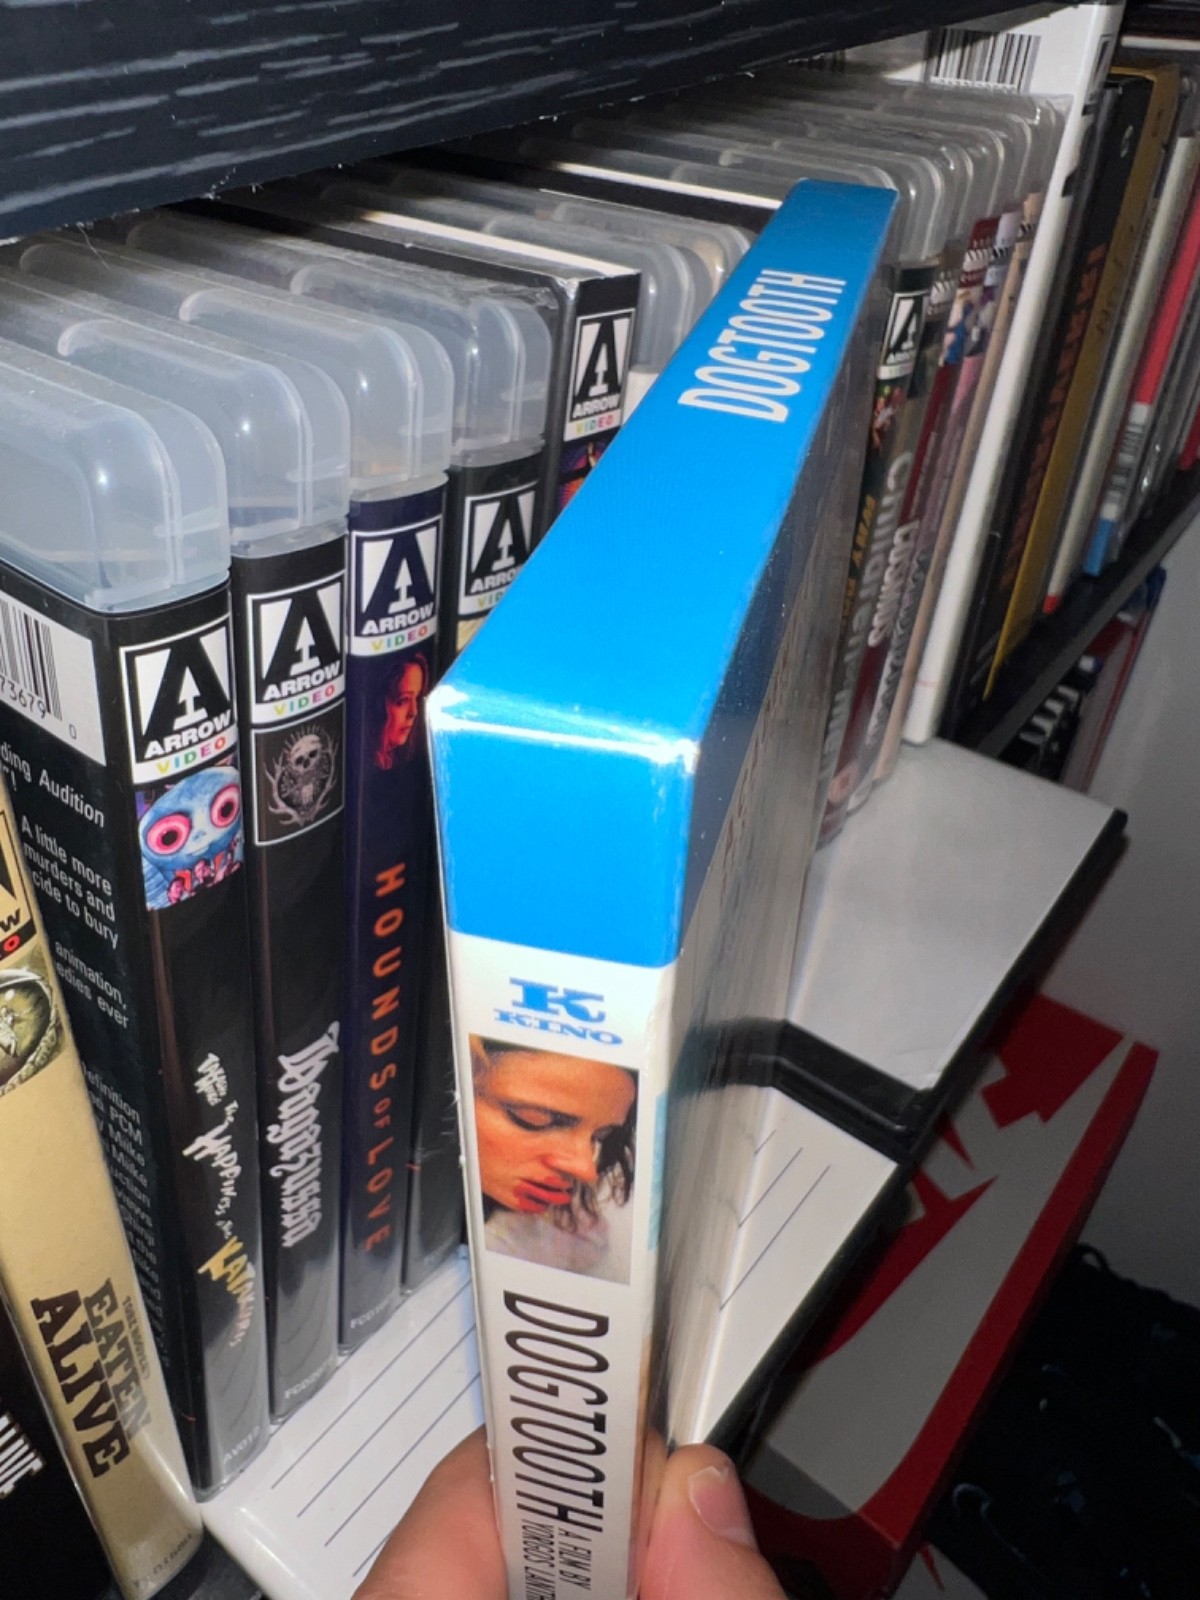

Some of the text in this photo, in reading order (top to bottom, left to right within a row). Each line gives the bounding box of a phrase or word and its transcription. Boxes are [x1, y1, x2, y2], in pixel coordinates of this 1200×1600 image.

[677, 269, 846, 423] DOGTOOTH
[572, 394, 622, 419] ARROW
[576, 417, 614, 436] VIDEO
[470, 566, 518, 593] ARRO
[361, 602, 434, 636] ARROW
[371, 625, 428, 651] VIDEO
[263, 660, 341, 701] ARROW
[274, 684, 336, 716] VIDEO
[144, 709, 232, 760] ARROW
[156, 736, 227, 774] VIDEO
[39, 768, 105, 828] Audition
[35, 824, 67, 864] little
[71, 856, 112, 897] more
[65, 893, 80, 917] to
[84, 906, 118, 949] bury
[86, 890, 116, 922] and
[97, 996, 129, 1029] ever
[509, 976, 606, 1024] K
[494, 1008, 623, 1045] KINO
[366, 863, 405, 1252] HOUNDS OF LOVE
[84, 1277, 152, 1441] EATEN
[30, 1289, 131, 1478] ALIVE
[503, 1290, 609, 1533] DOGTOOTH
[521, 1518, 555, 1568] YORGOS
[558, 1527, 592, 1591] A FILM BY
